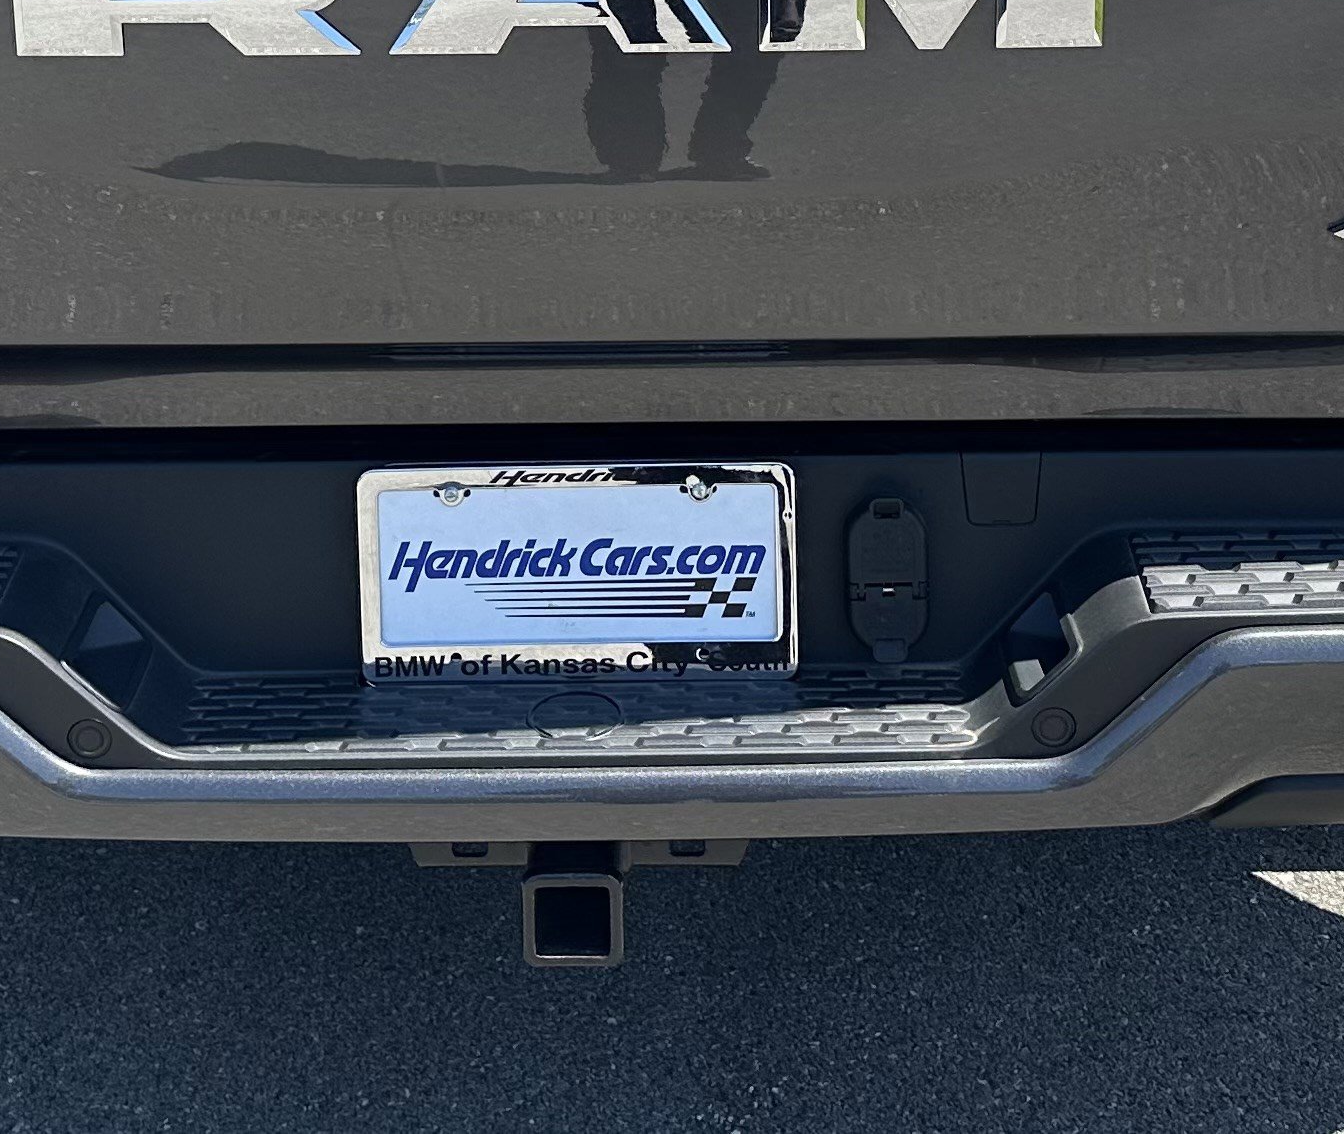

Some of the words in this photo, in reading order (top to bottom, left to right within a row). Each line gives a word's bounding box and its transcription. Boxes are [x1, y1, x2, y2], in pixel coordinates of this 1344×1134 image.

[374, 655, 446, 678] BMW
[460, 653, 492, 676] of
[500, 652, 615, 676] Kansas
[626, 650, 688, 678] City
